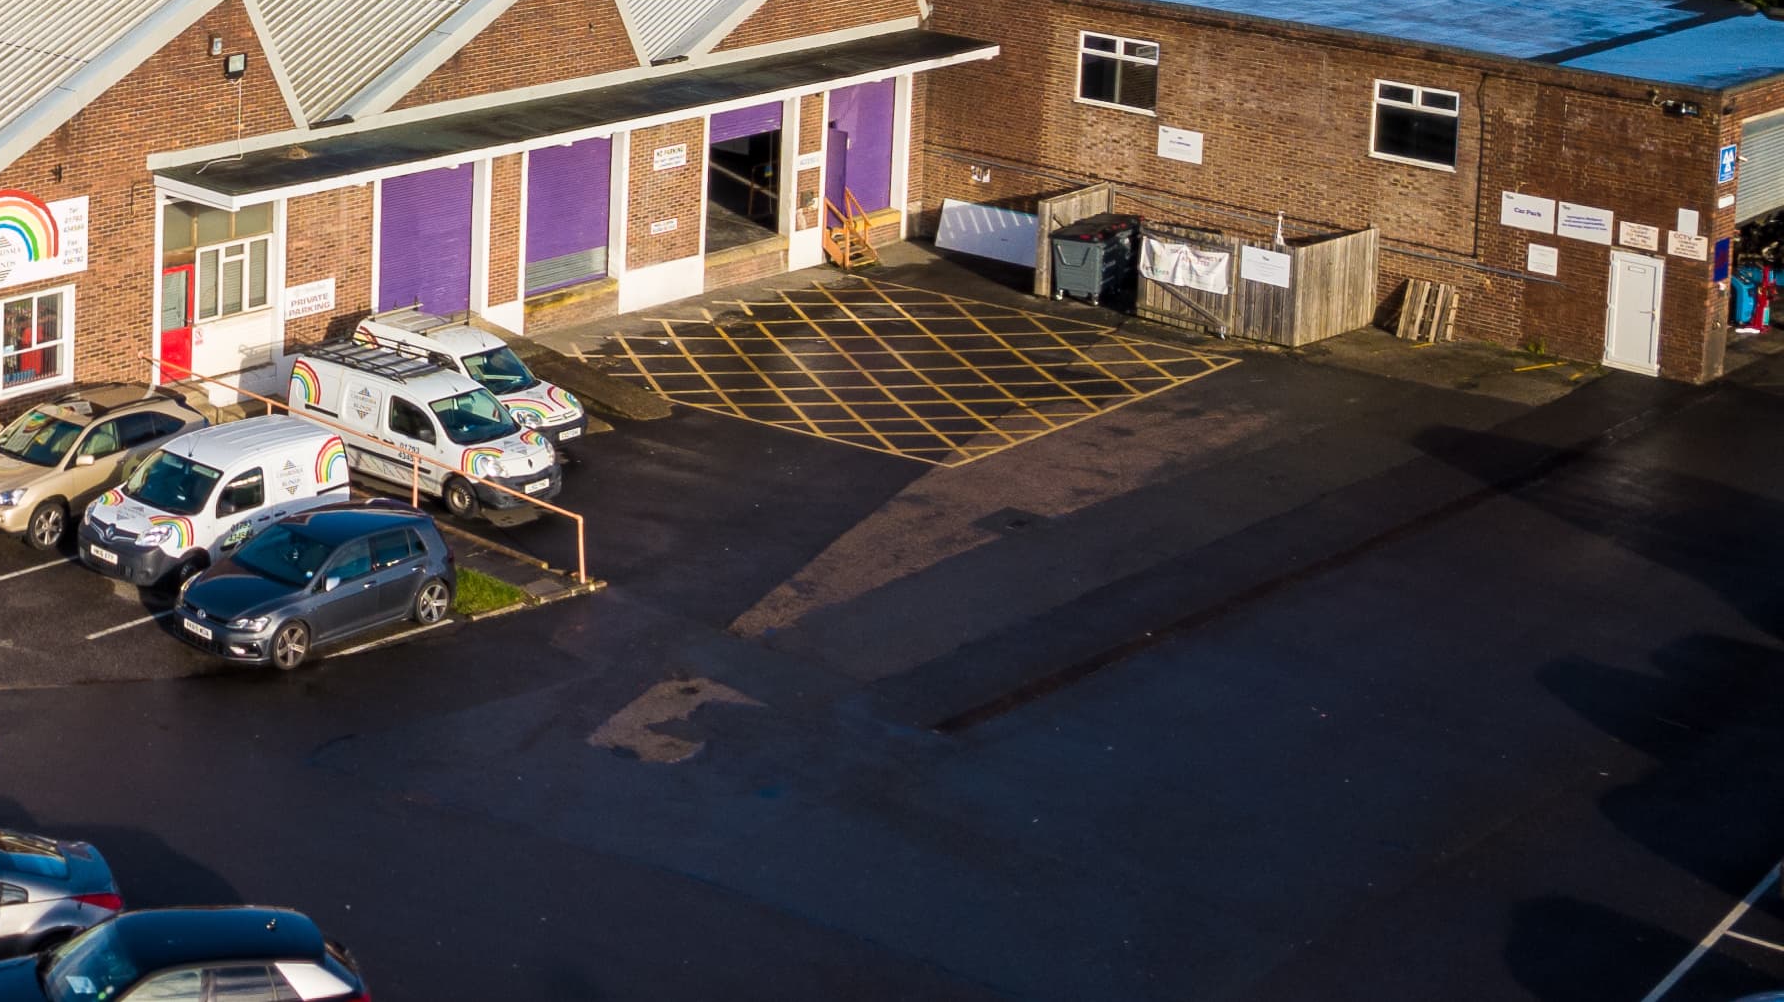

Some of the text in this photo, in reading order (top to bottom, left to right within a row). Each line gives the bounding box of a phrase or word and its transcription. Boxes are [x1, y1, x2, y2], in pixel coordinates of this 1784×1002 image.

[1527, 209, 1542, 217] Park
[290, 293, 329, 307] PRIVATE
[289, 302, 331, 317] PARKING
[400, 442, 419, 454] 01793
